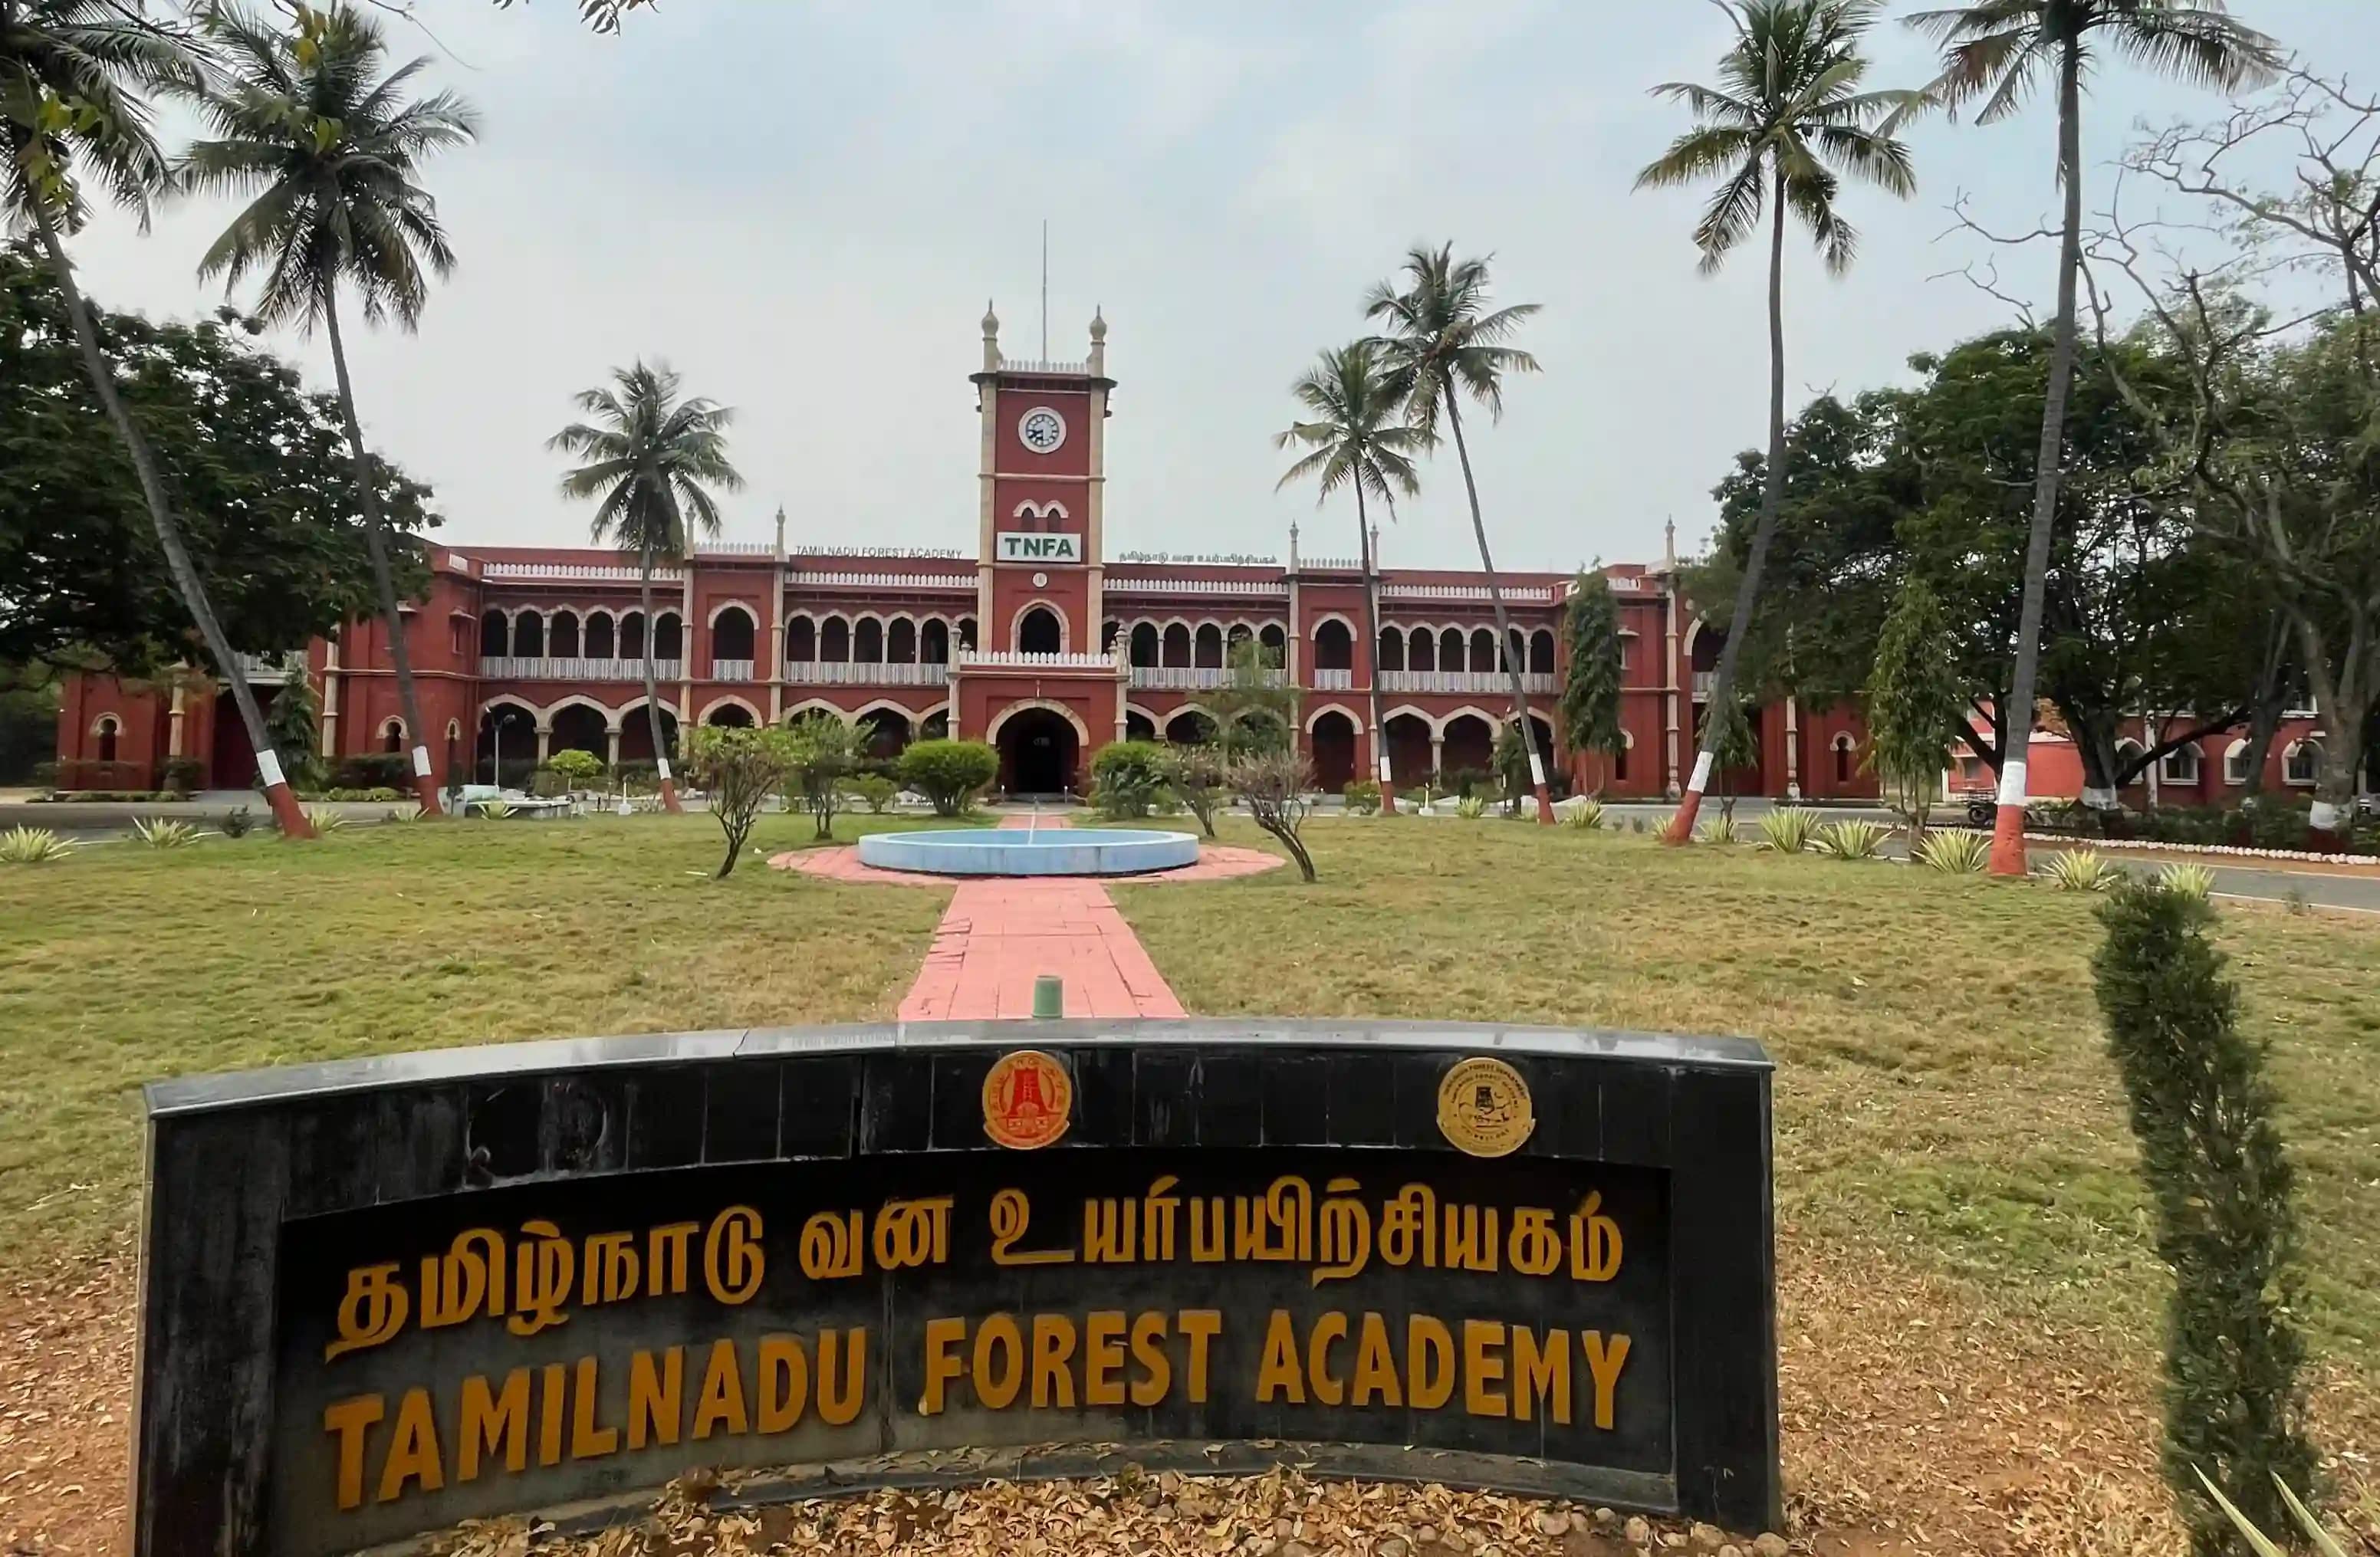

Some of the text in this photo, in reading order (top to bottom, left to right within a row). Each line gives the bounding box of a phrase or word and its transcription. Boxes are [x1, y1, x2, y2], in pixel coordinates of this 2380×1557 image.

[863, 547, 905, 558] FOREST
[909, 548, 963, 560] ACADEMY
[1004, 537, 1074, 557] TNFA
[325, 1204, 765, 1363] தமிழ்நாடு
[799, 1196, 954, 1279] வன
[325, 1309, 1632, 1510] TAMILNADU FOREST ACADEMY
